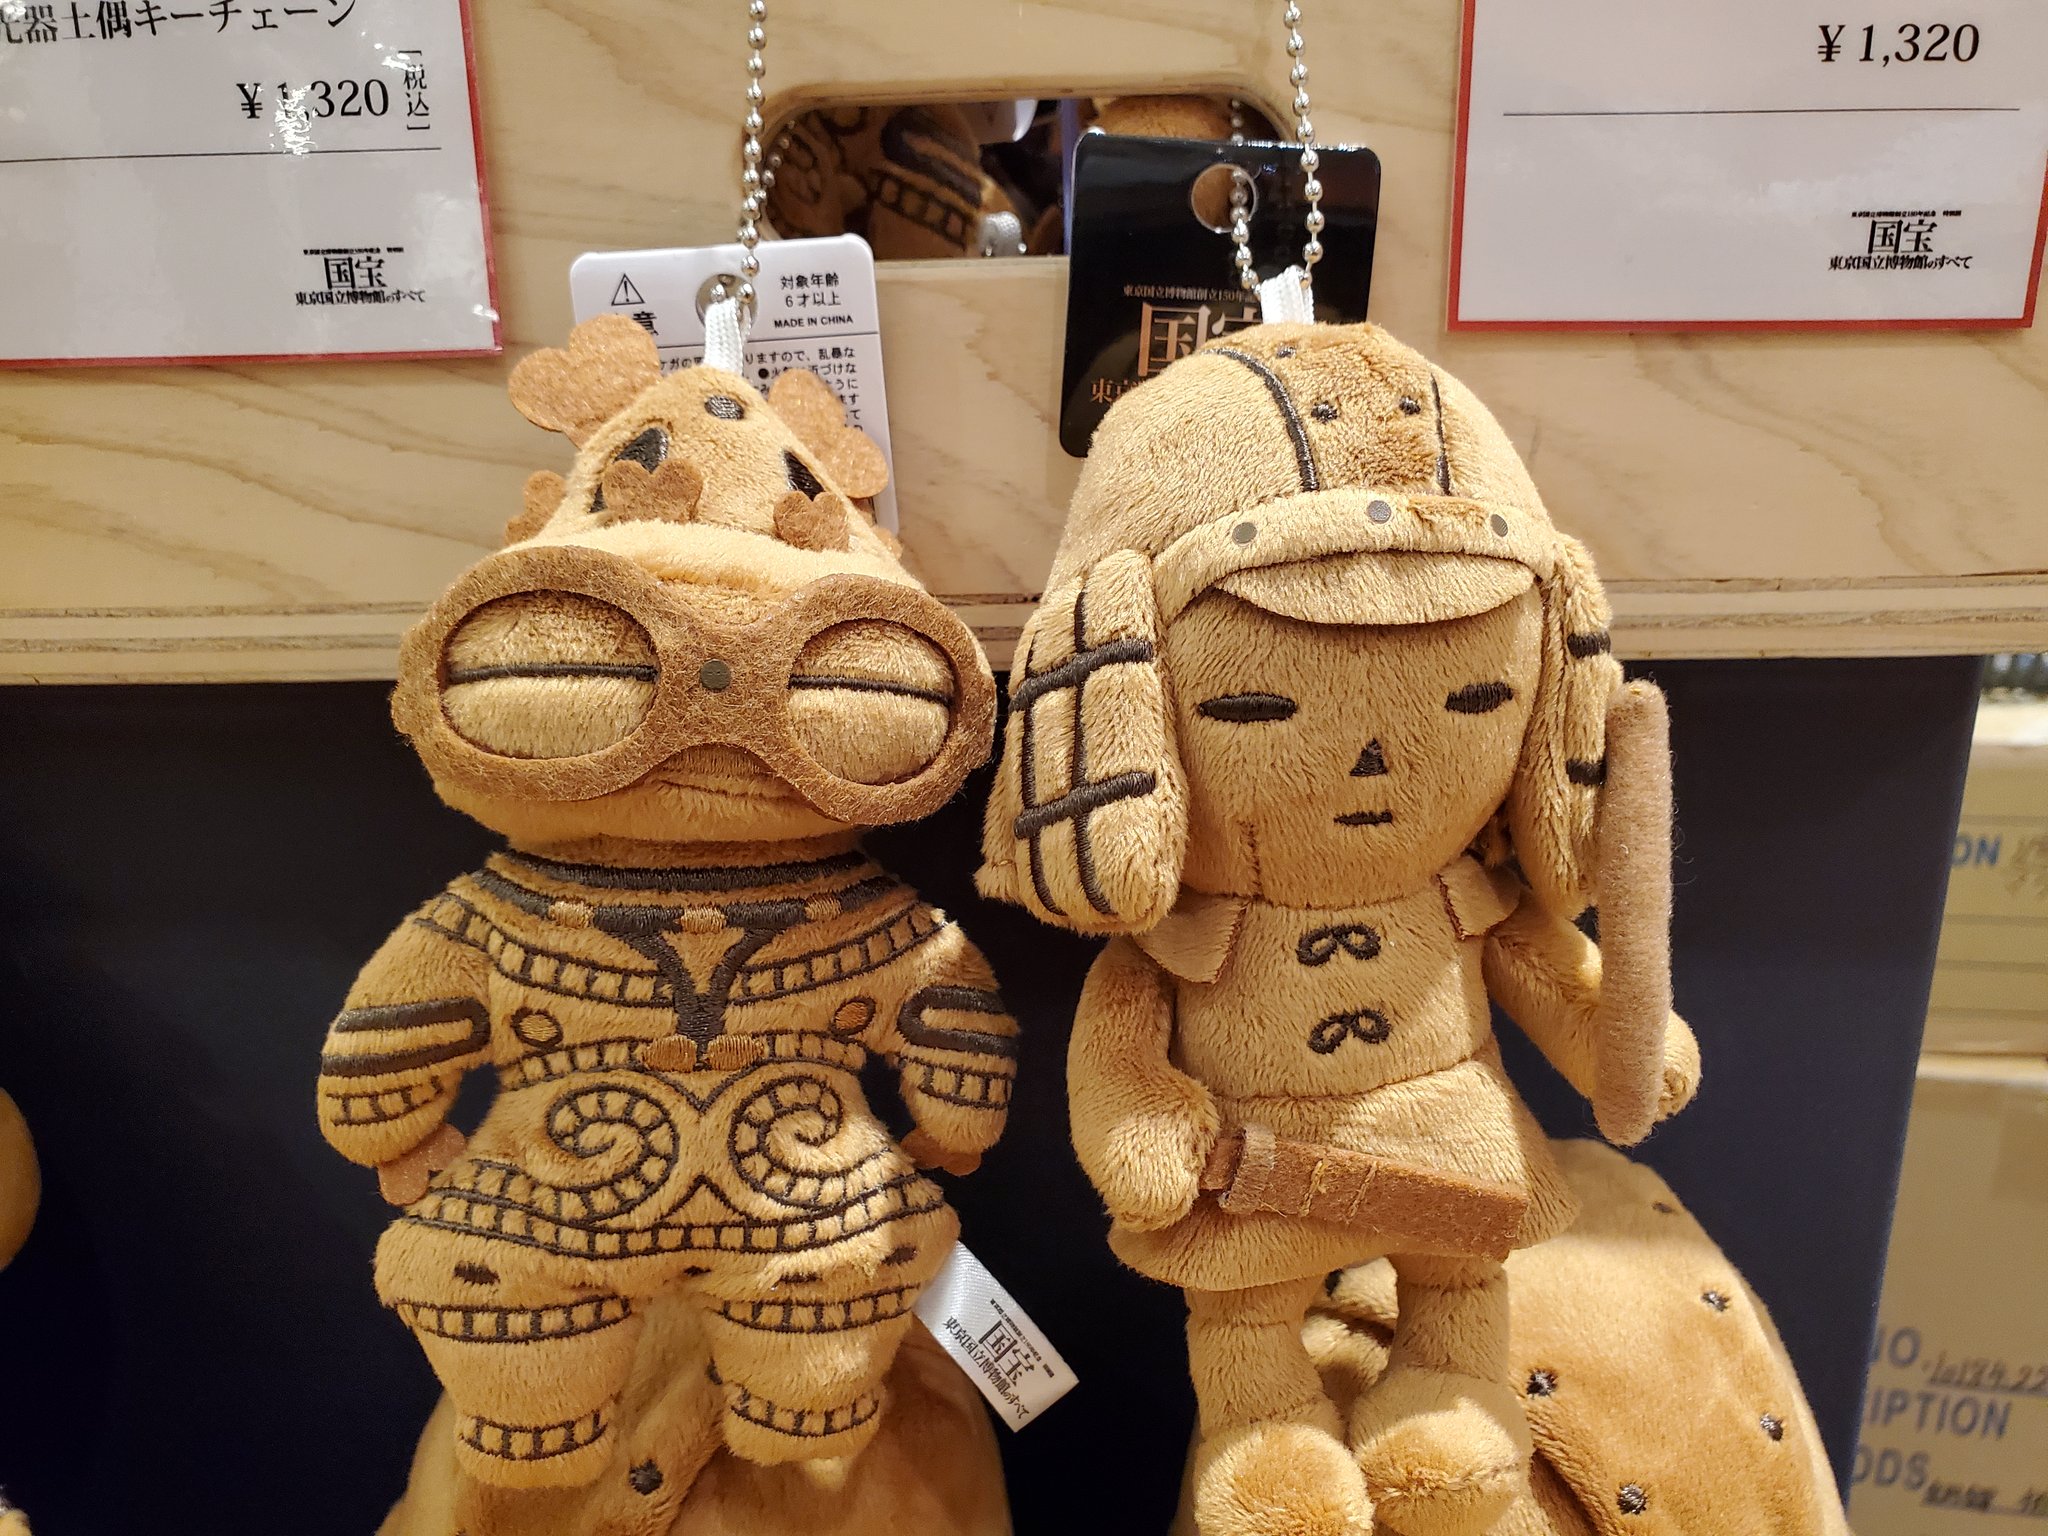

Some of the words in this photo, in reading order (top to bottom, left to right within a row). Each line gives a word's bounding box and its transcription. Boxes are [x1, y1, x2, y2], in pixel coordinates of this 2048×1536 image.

[1868, 219, 1938, 254] 国宝
[1828, 254, 1973, 271] 東京国立博物館のすべて
[324, 256, 387, 290] 国宝
[780, 272, 840, 290] 対象年齢
[295, 289, 426, 306] 東京国立博物館のすべて
[785, 291, 841, 308] 6才以上
[774, 318, 805, 328] MADE
[807, 317, 818, 326] IN
[820, 314, 853, 326] CHINA
[979, 1320, 1035, 1386] 国宝
[943, 1316, 1030, 1419] 東京国立博物館のすべて
